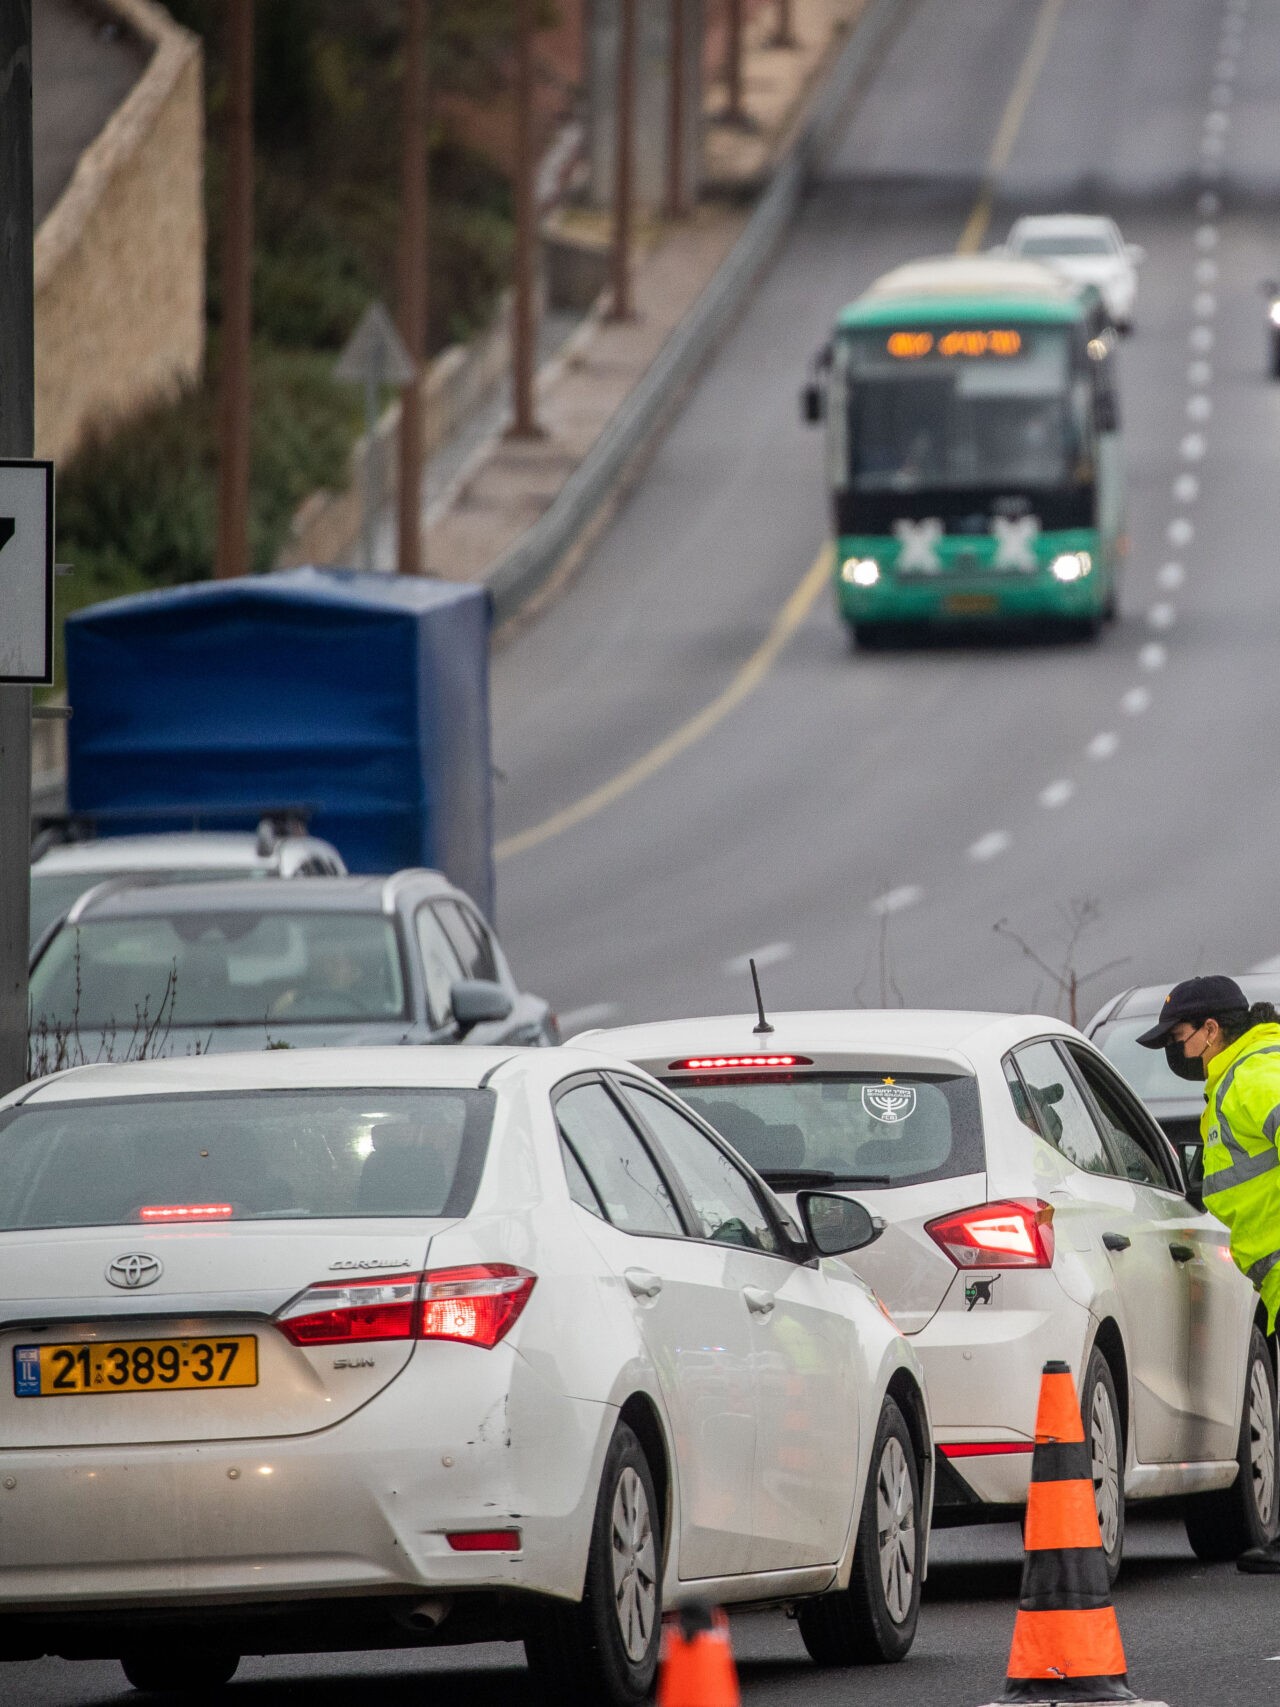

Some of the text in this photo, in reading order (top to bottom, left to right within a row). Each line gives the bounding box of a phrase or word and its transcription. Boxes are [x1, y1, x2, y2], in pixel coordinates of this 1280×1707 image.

[328, 1259, 411, 1270] COROLLA
[333, 1357, 375, 1369] SUN
[22, 1361, 36, 1380] IL
